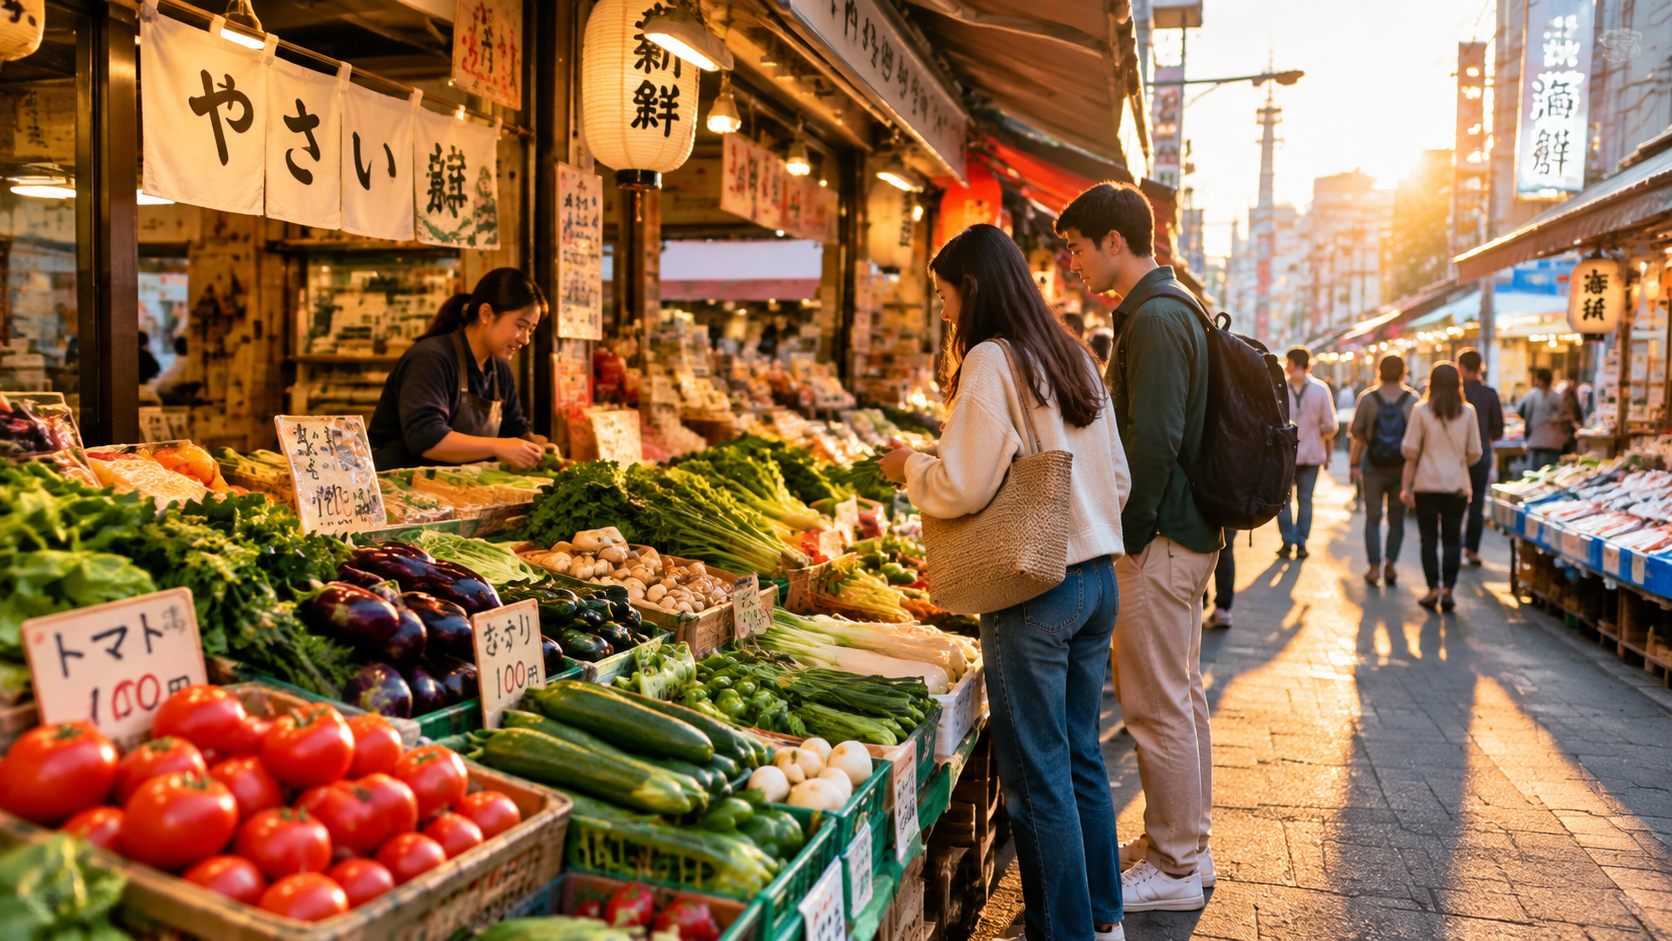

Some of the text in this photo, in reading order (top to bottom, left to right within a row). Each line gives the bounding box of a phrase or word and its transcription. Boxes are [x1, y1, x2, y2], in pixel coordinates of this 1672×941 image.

[188, 69, 396, 191] やさい
[55, 612, 163, 678] トマト
[496, 660, 539, 700] 100円
